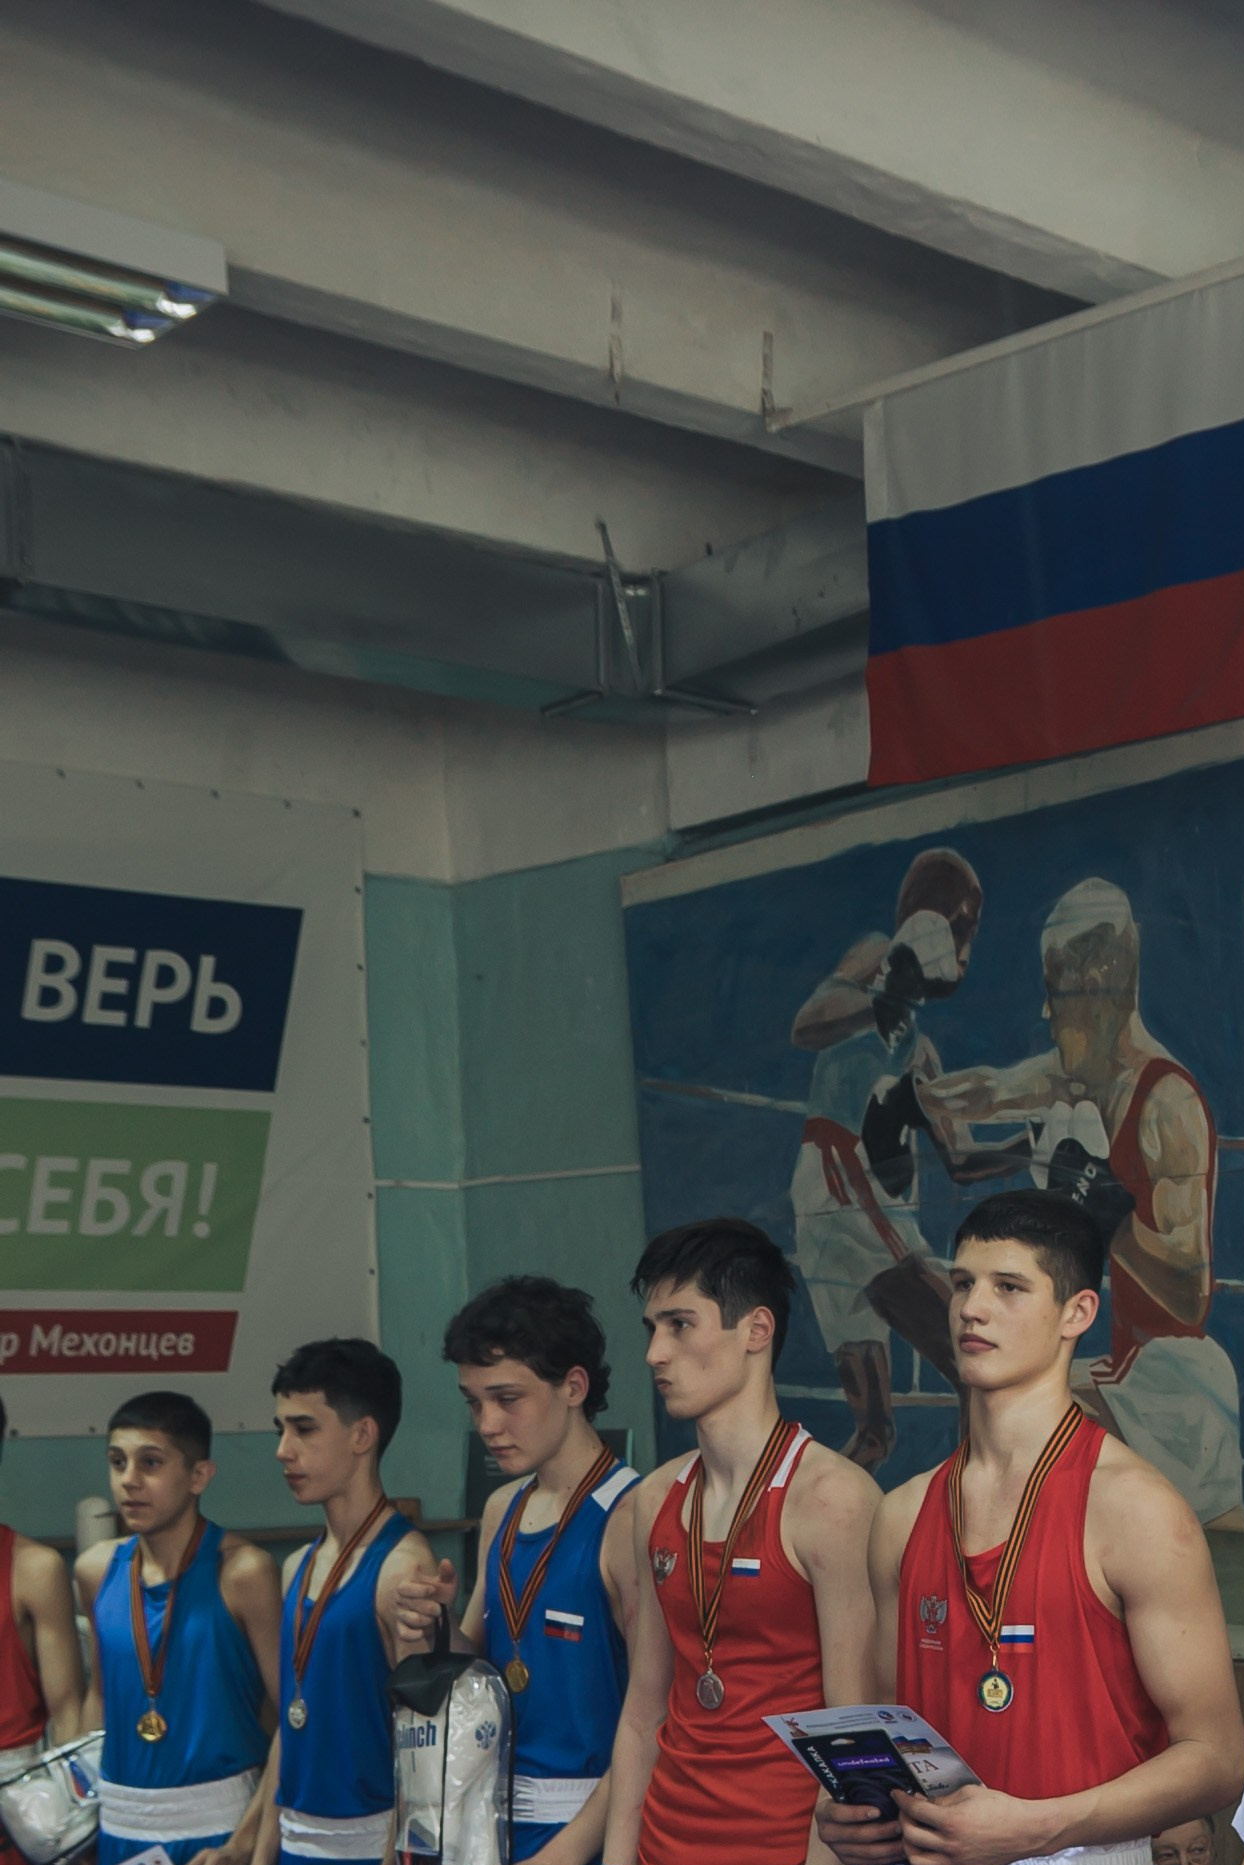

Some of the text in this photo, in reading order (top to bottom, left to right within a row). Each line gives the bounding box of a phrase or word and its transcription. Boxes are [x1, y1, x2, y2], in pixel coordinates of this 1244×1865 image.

[20, 938, 243, 1034] ВЕРЬ
[0, 1152, 218, 1239] СЕБЯ!
[30, 1324, 195, 1359] Мехонцев
